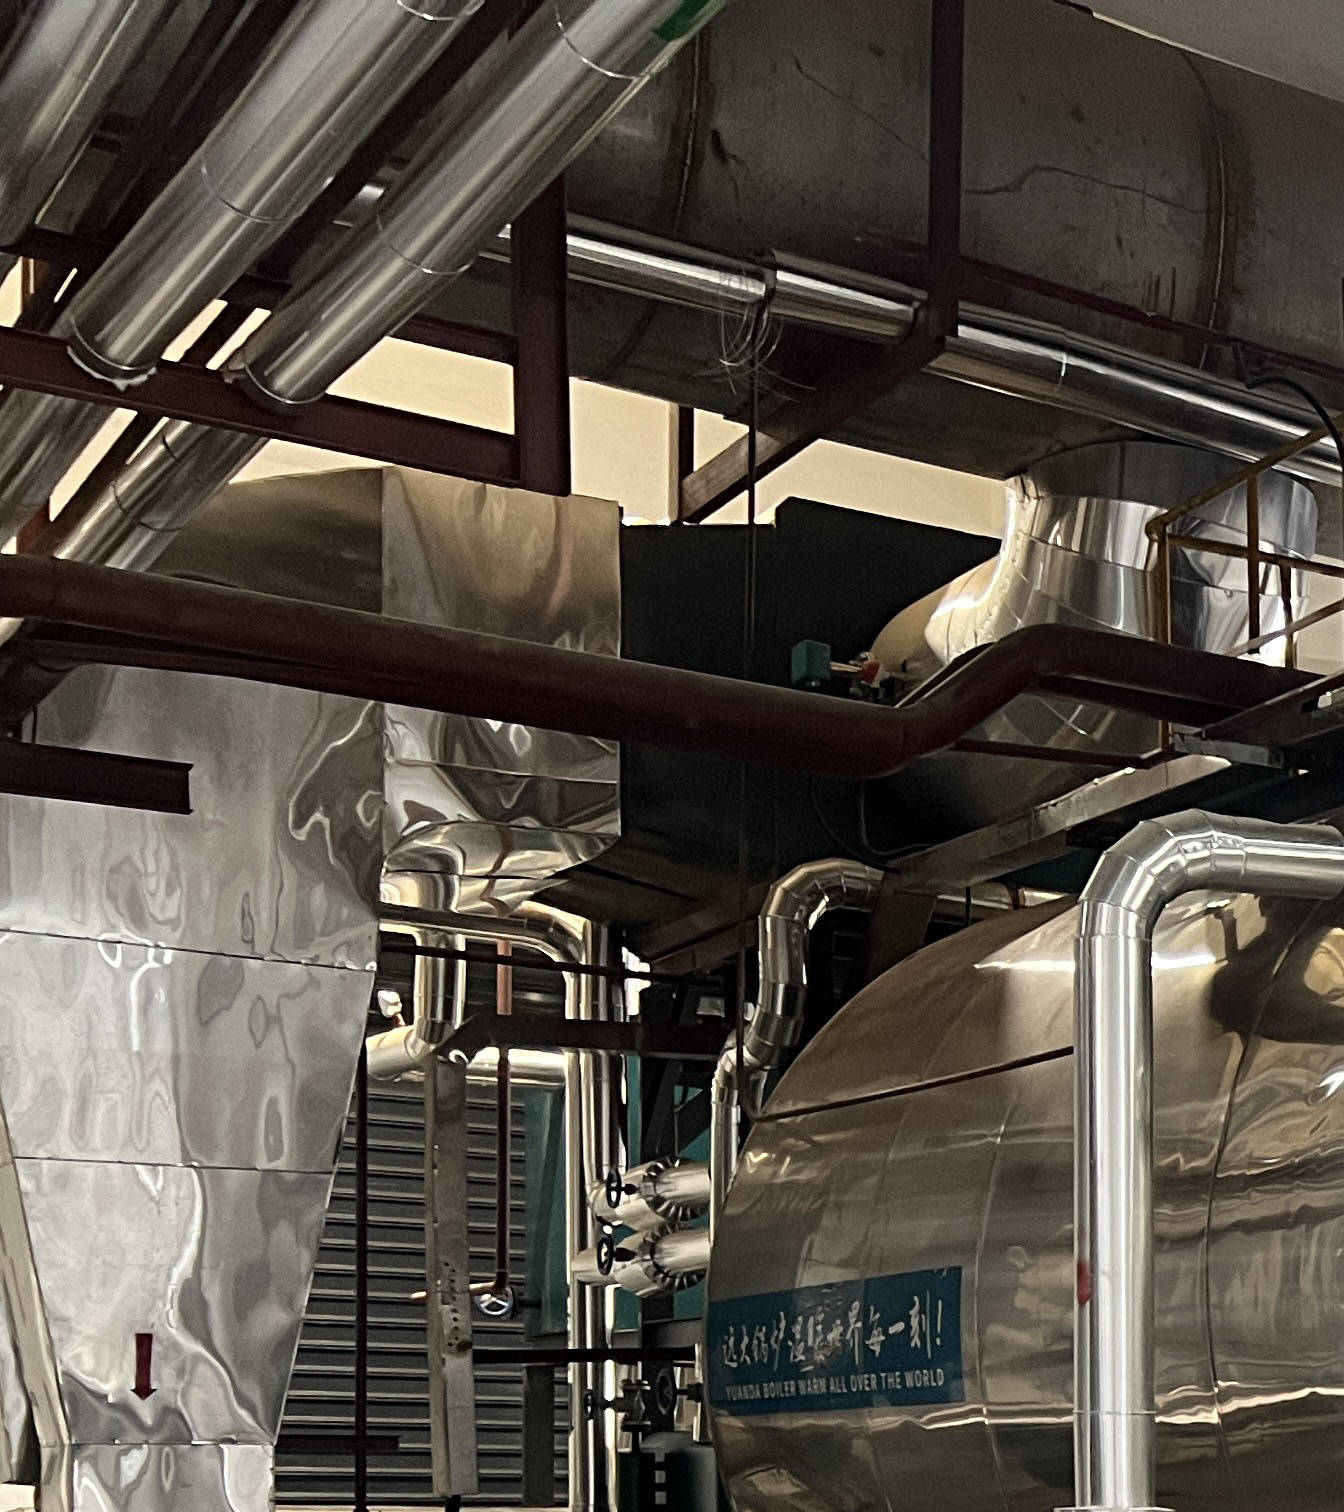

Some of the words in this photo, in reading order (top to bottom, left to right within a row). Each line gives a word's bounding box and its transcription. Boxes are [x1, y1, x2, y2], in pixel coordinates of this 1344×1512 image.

[726, 1383, 760, 1401] YUANDA
[762, 1381, 796, 1399] BOILER
[798, 1377, 826, 1395] WARM
[829, 1376, 847, 1393] ALL
[850, 1373, 877, 1392] OVER
[880, 1371, 901, 1390] THE
[905, 1368, 944, 1388] WORLD
